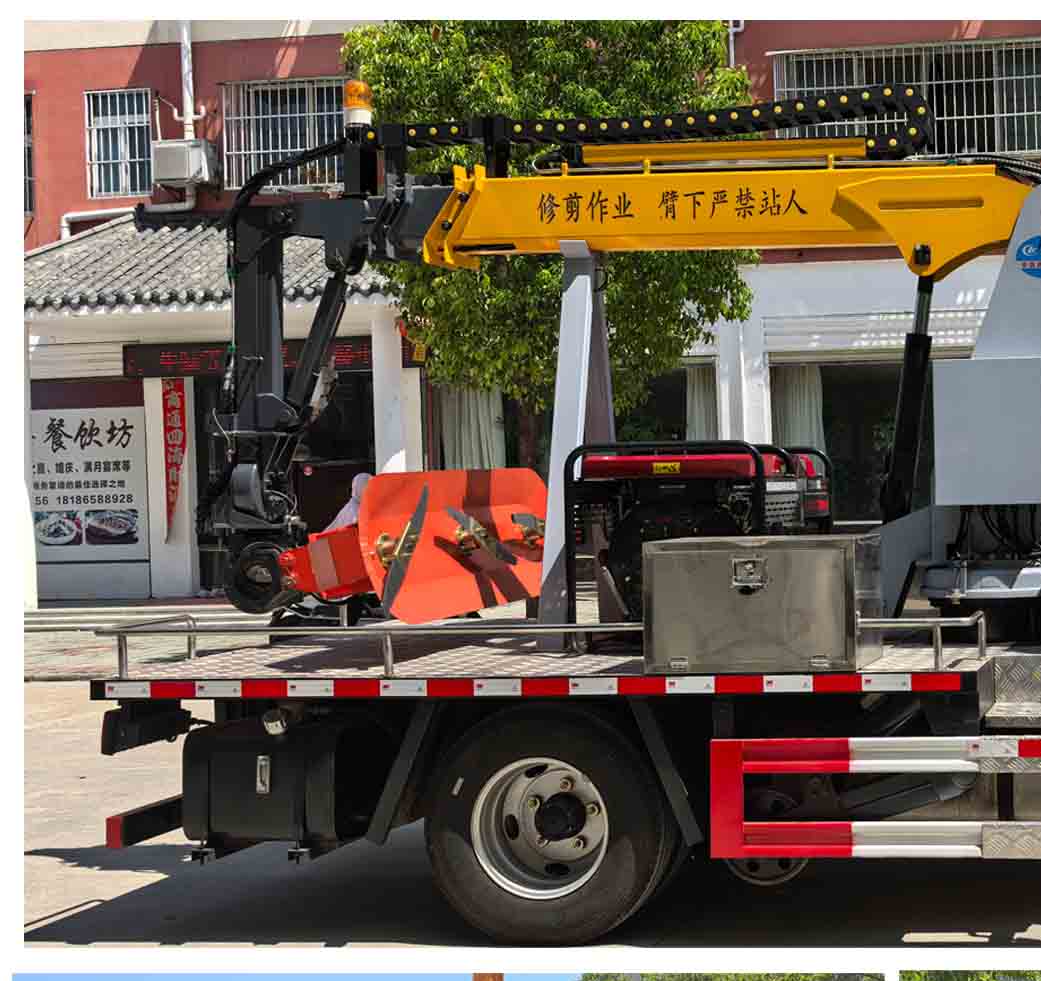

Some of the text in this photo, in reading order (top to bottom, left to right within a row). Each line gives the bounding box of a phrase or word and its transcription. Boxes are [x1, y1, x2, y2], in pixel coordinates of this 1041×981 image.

[538, 186, 808, 223] 修剪作业 臂下严禁站人
[32, 417, 134, 453] 餐饮坊
[56, 494, 134, 505] 18186588928
